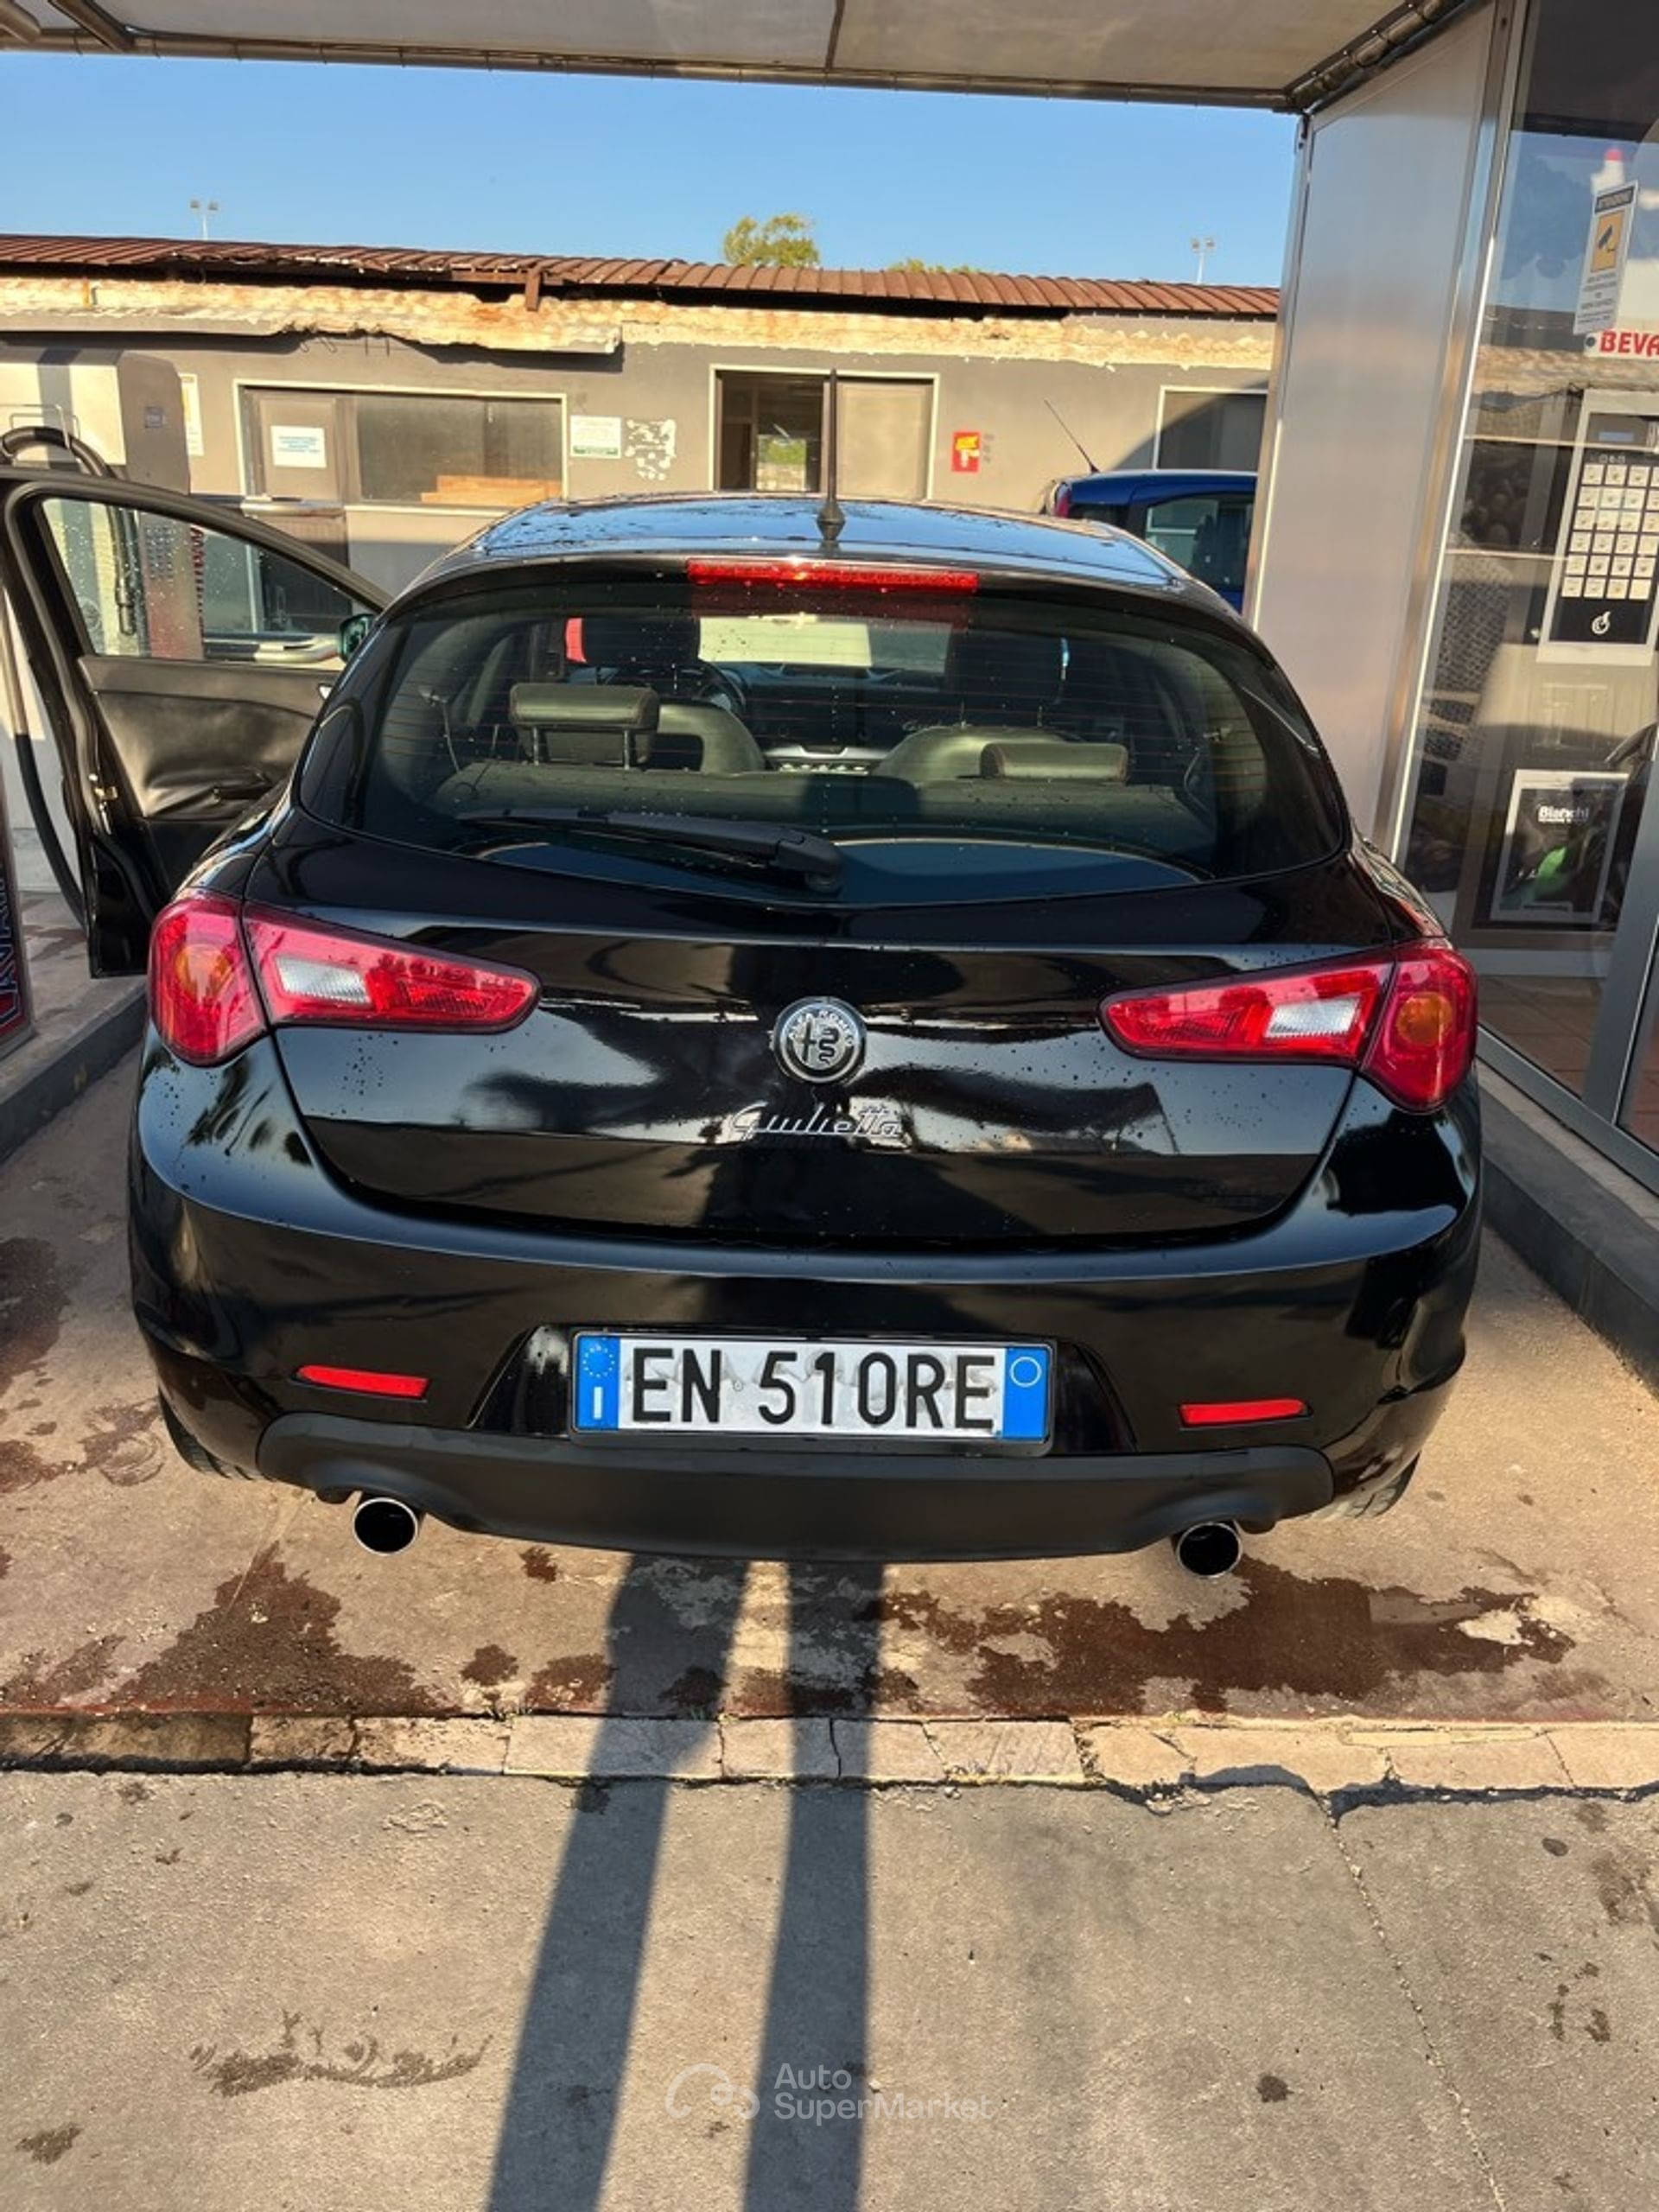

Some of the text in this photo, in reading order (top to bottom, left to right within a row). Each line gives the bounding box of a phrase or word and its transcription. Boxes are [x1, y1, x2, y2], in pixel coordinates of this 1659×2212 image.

[1600, 331, 1659, 357] BEVA
[733, 1101, 902, 1140] Giulietta
[632, 1347, 721, 1423] EN
[758, 1351, 995, 1429] 510RE
